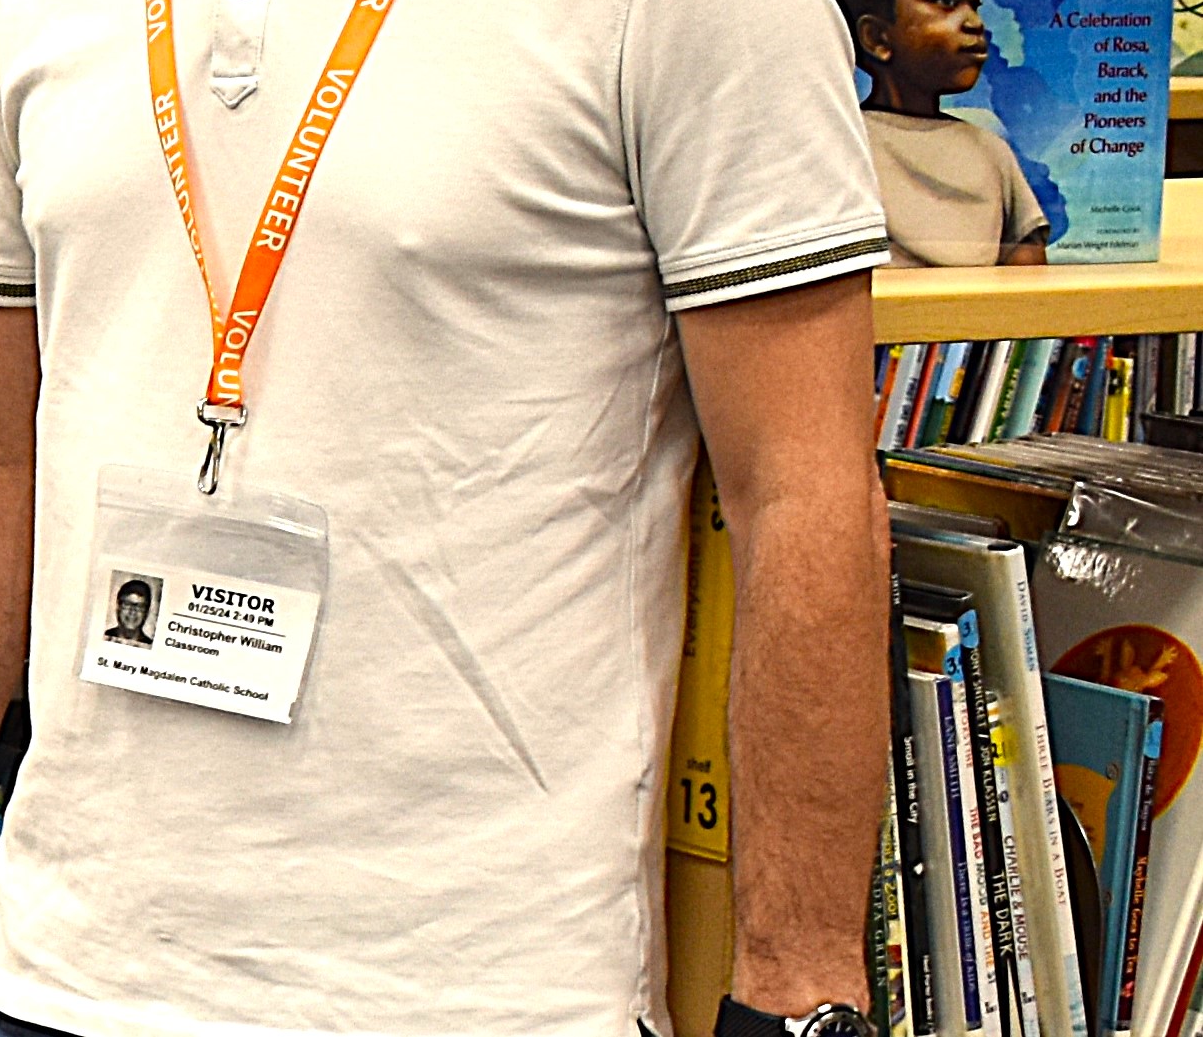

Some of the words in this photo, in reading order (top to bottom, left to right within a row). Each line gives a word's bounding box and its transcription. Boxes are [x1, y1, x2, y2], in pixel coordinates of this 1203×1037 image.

[1048, 12, 1064, 29] A
[1066, 11, 1151, 28] Celebration
[1094, 37, 1110, 53] of
[1112, 37, 1150, 56] Rosa,
[1097, 61, 1148, 80] Barack,
[1093, 88, 1120, 104] and
[1123, 87, 1147, 104] the
[1083, 113, 1146, 130] Pioneers
[256, 66, 355, 252] VOLUNTEER
[1070, 138, 1086, 155] of
[1088, 138, 1145, 158] Change
[217, 310, 258, 405] VOLUN
[191, 584, 276, 614] VISITOR
[187, 602, 231, 620] 01/25/24
[257, 616, 275, 628] PM
[164, 637, 220, 656] Classroom
[167, 620, 238, 645] Christopher
[239, 635, 283, 654] William
[97, 656, 109, 668] St.
[113, 659, 137, 675] Mary
[139, 665, 187, 685] Magdalen
[189, 675, 231, 694] Catholic
[233, 685, 269, 701] School
[973, 679, 988, 728] SNICKET
[903, 736, 915, 770] Small
[980, 744, 992, 767] JON
[906, 771, 916, 780] in
[680, 776, 718, 831] 13
[907, 782, 918, 800] the
[982, 770, 998, 823] KLASSEN
[907, 801, 920, 825] City
[1003, 834, 1023, 899] CHARLIE
[991, 868, 1009, 904] THE
[1012, 900, 1023, 910] &
[995, 911, 1015, 957] DARK
[1013, 913, 1029, 962] MOUSE
